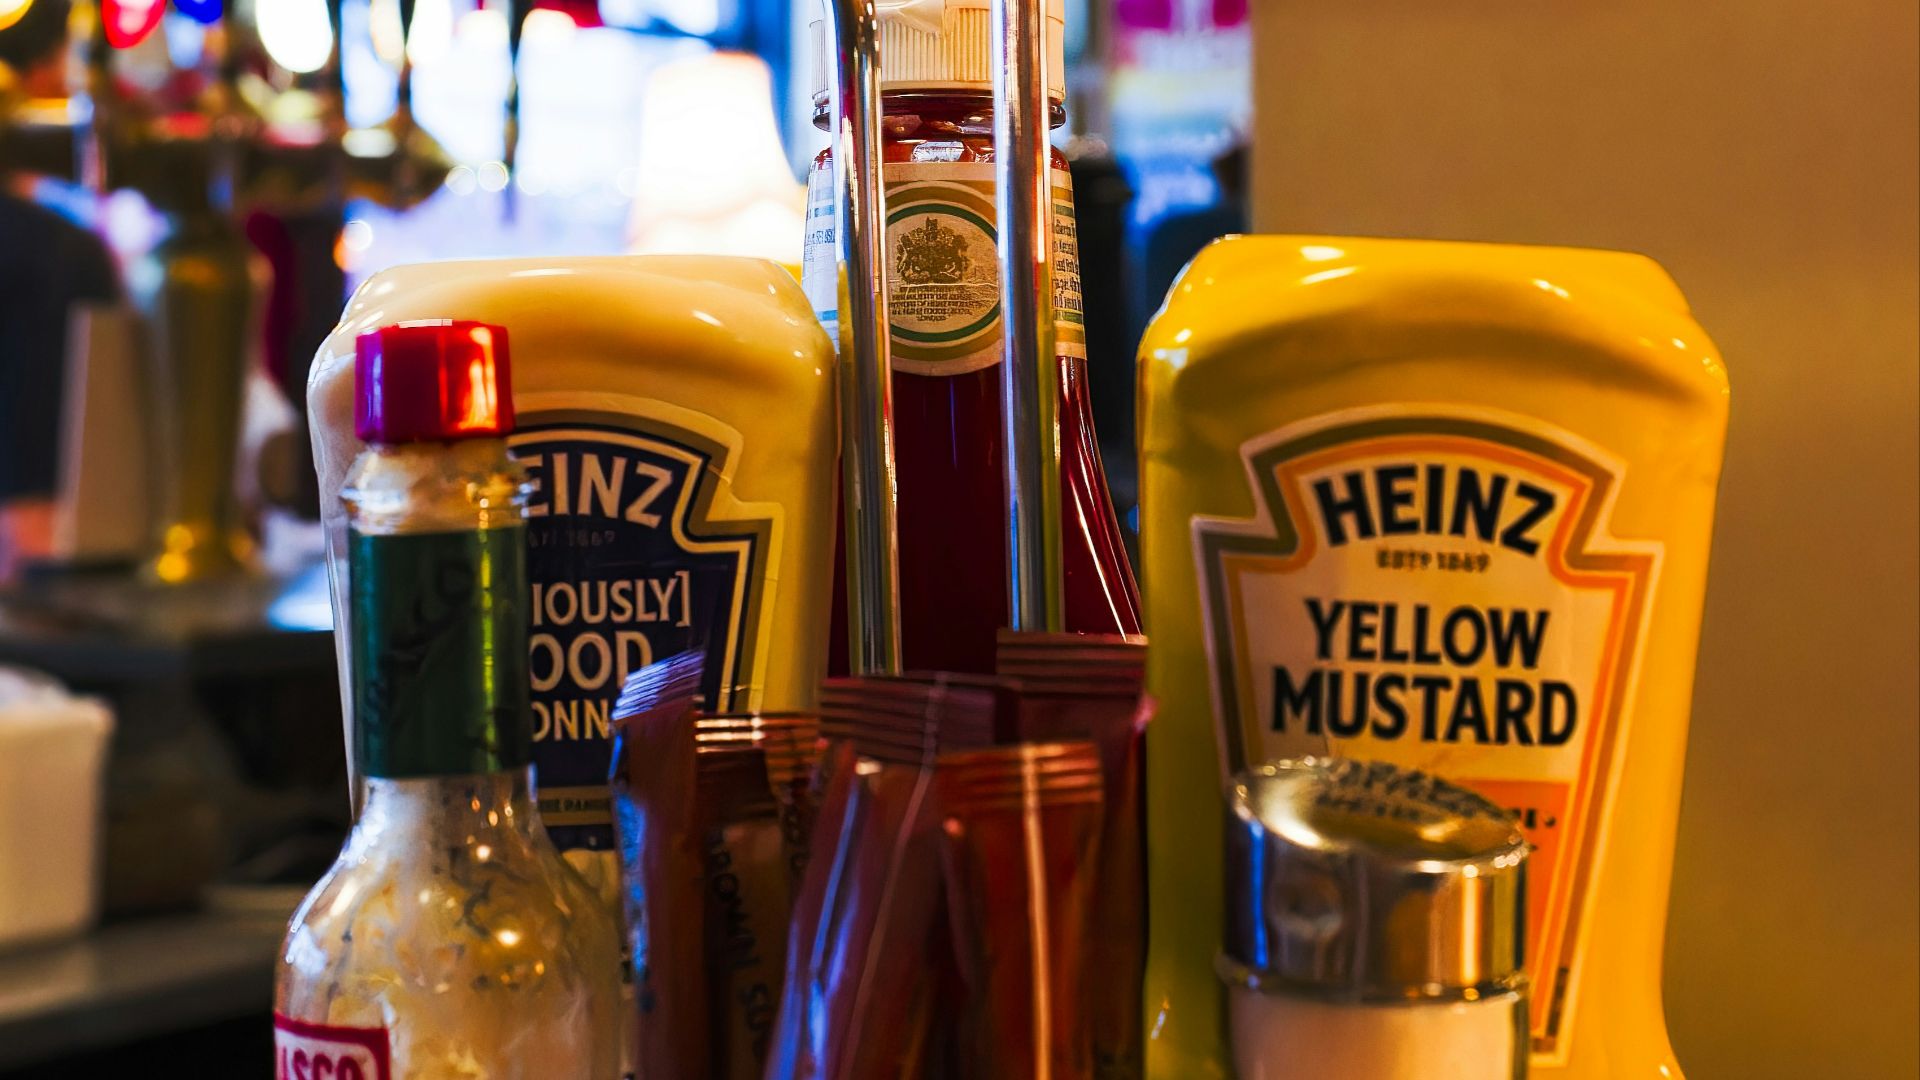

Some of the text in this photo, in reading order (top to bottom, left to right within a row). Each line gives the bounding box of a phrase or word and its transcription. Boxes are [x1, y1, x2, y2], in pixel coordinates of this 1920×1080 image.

[1312, 464, 1558, 558] HEINZ
[1303, 598, 1551, 670] YELLOW
[1270, 665, 1579, 747] MUSTARD
